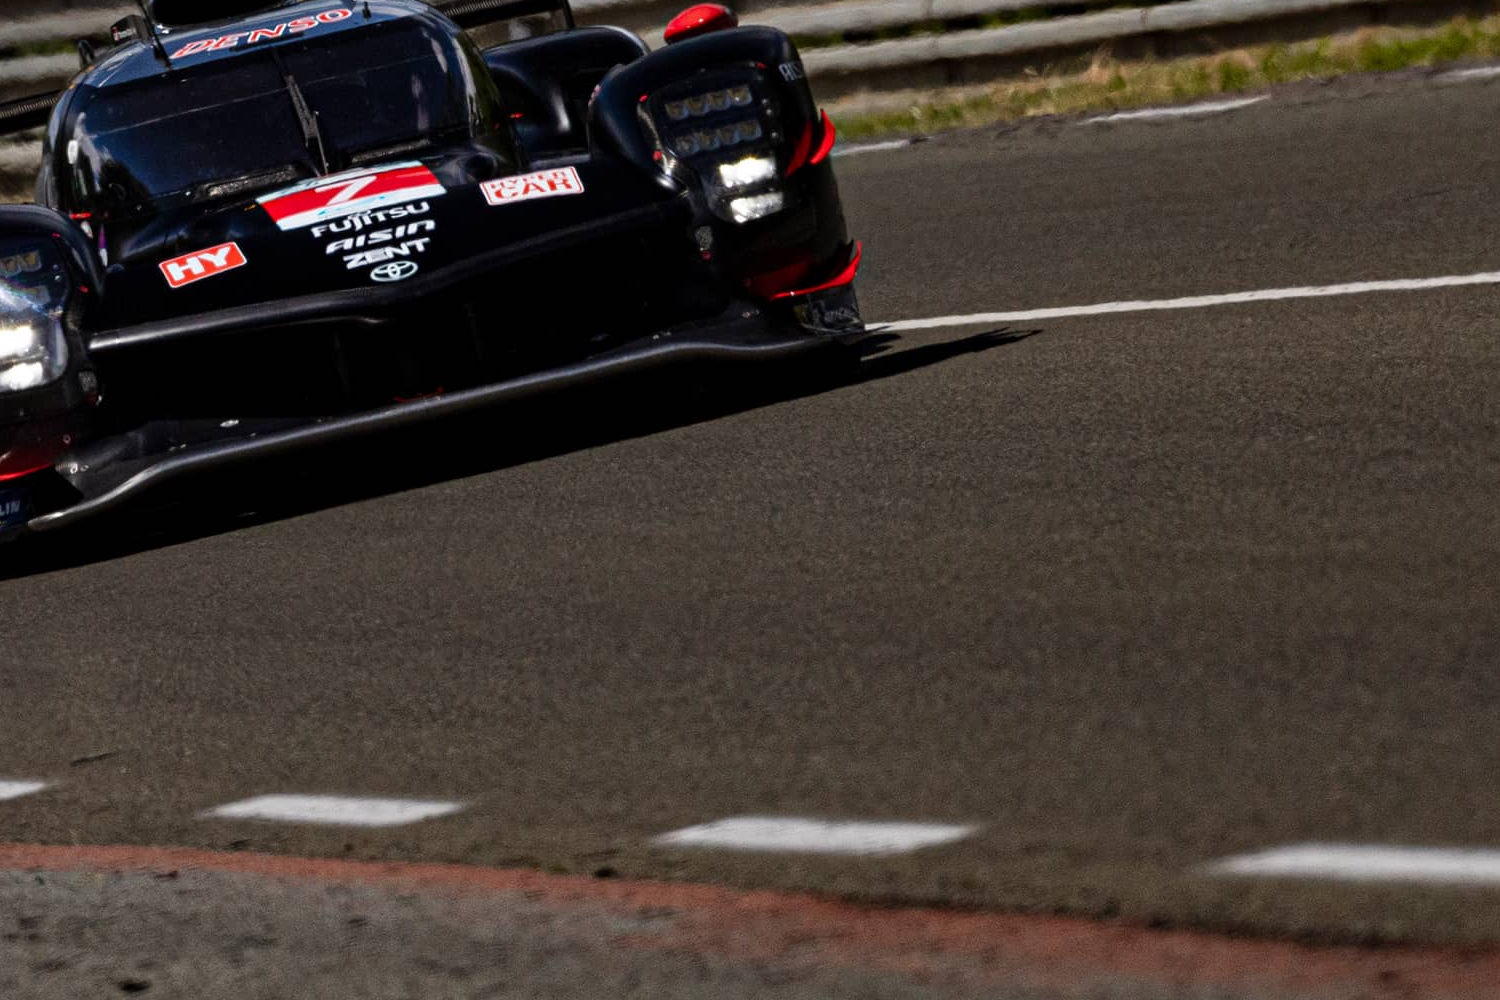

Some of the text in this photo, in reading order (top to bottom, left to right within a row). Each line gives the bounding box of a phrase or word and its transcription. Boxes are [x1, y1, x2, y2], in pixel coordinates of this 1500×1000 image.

[169, 7, 353, 60] DENSO
[313, 174, 378, 207] 7
[493, 177, 574, 199] CAR
[310, 200, 431, 239] FUJITSU
[167, 246, 232, 282] HY
[341, 236, 432, 271] ZENT
